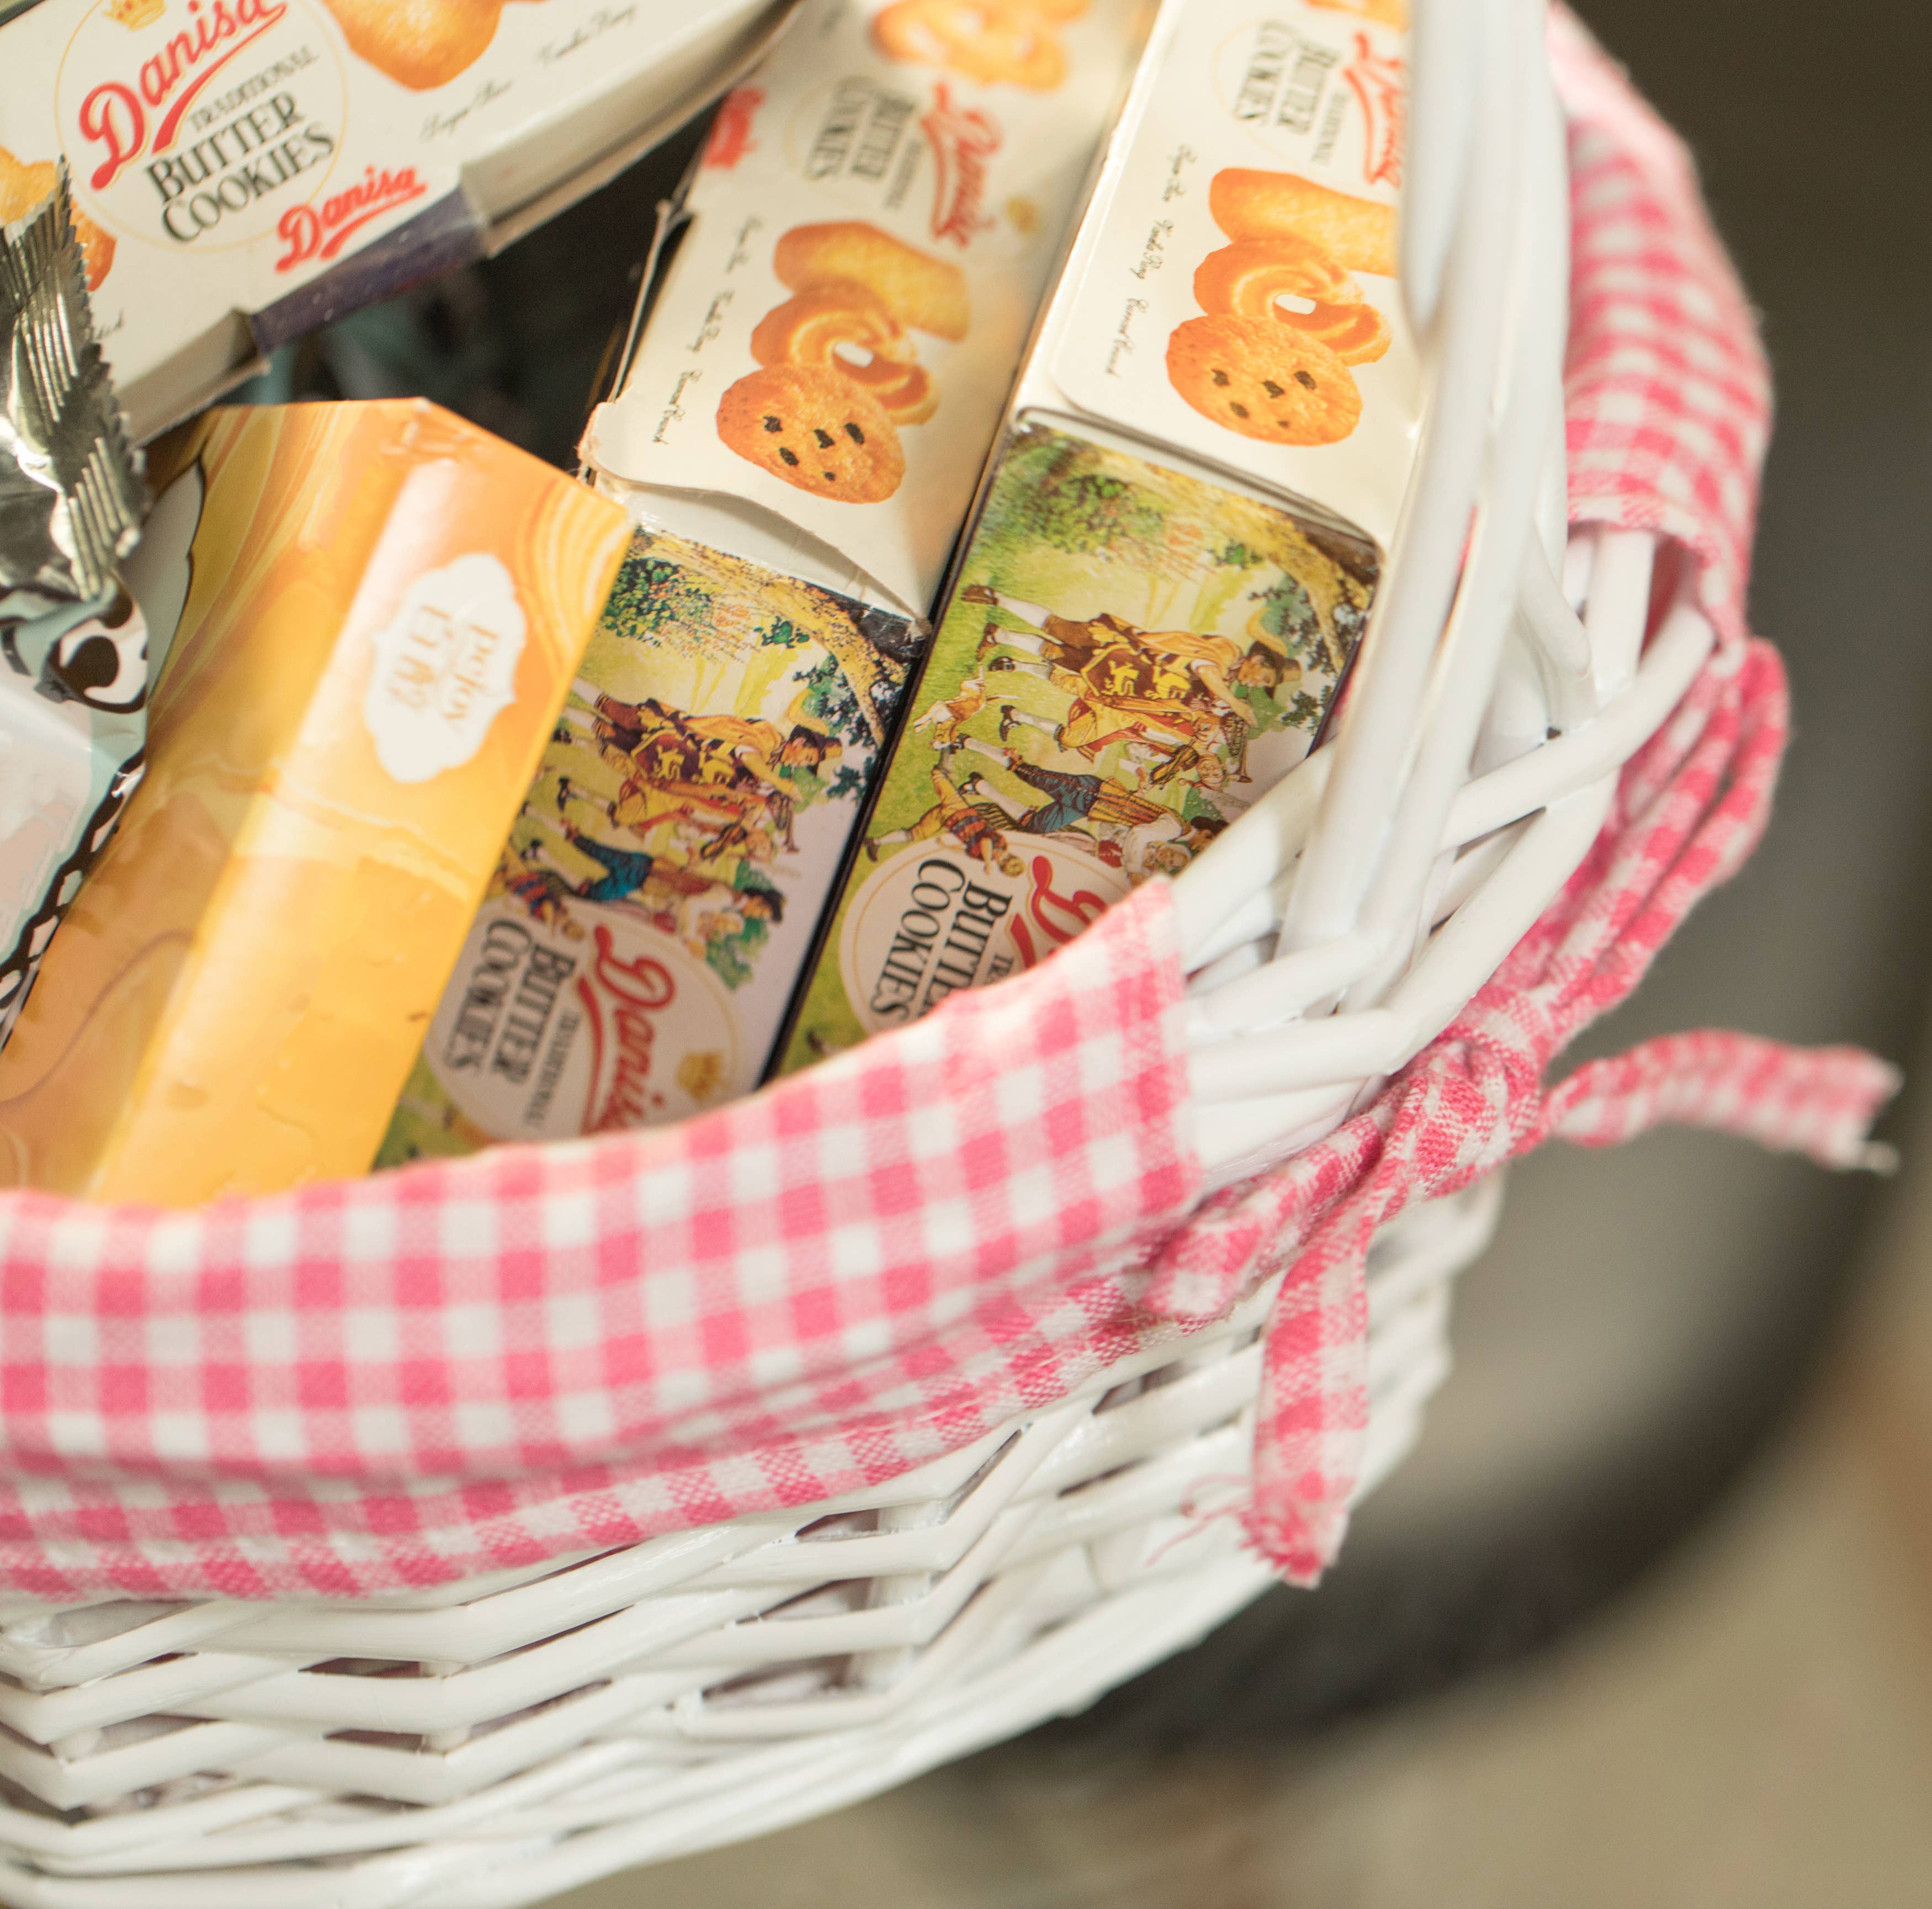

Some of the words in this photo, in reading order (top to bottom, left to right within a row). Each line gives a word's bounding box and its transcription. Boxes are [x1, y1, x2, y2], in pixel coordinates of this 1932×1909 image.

[79, 0, 287, 190] Danisa
[144, 90, 306, 203] BUTTER
[162, 122, 336, 243] COOKIES
[275, 165, 428, 274] Danisa
[442, 919, 533, 1077] COOKIES
[492, 941, 577, 1086] BUTTER
[869, 859, 966, 1023] COOKIES
